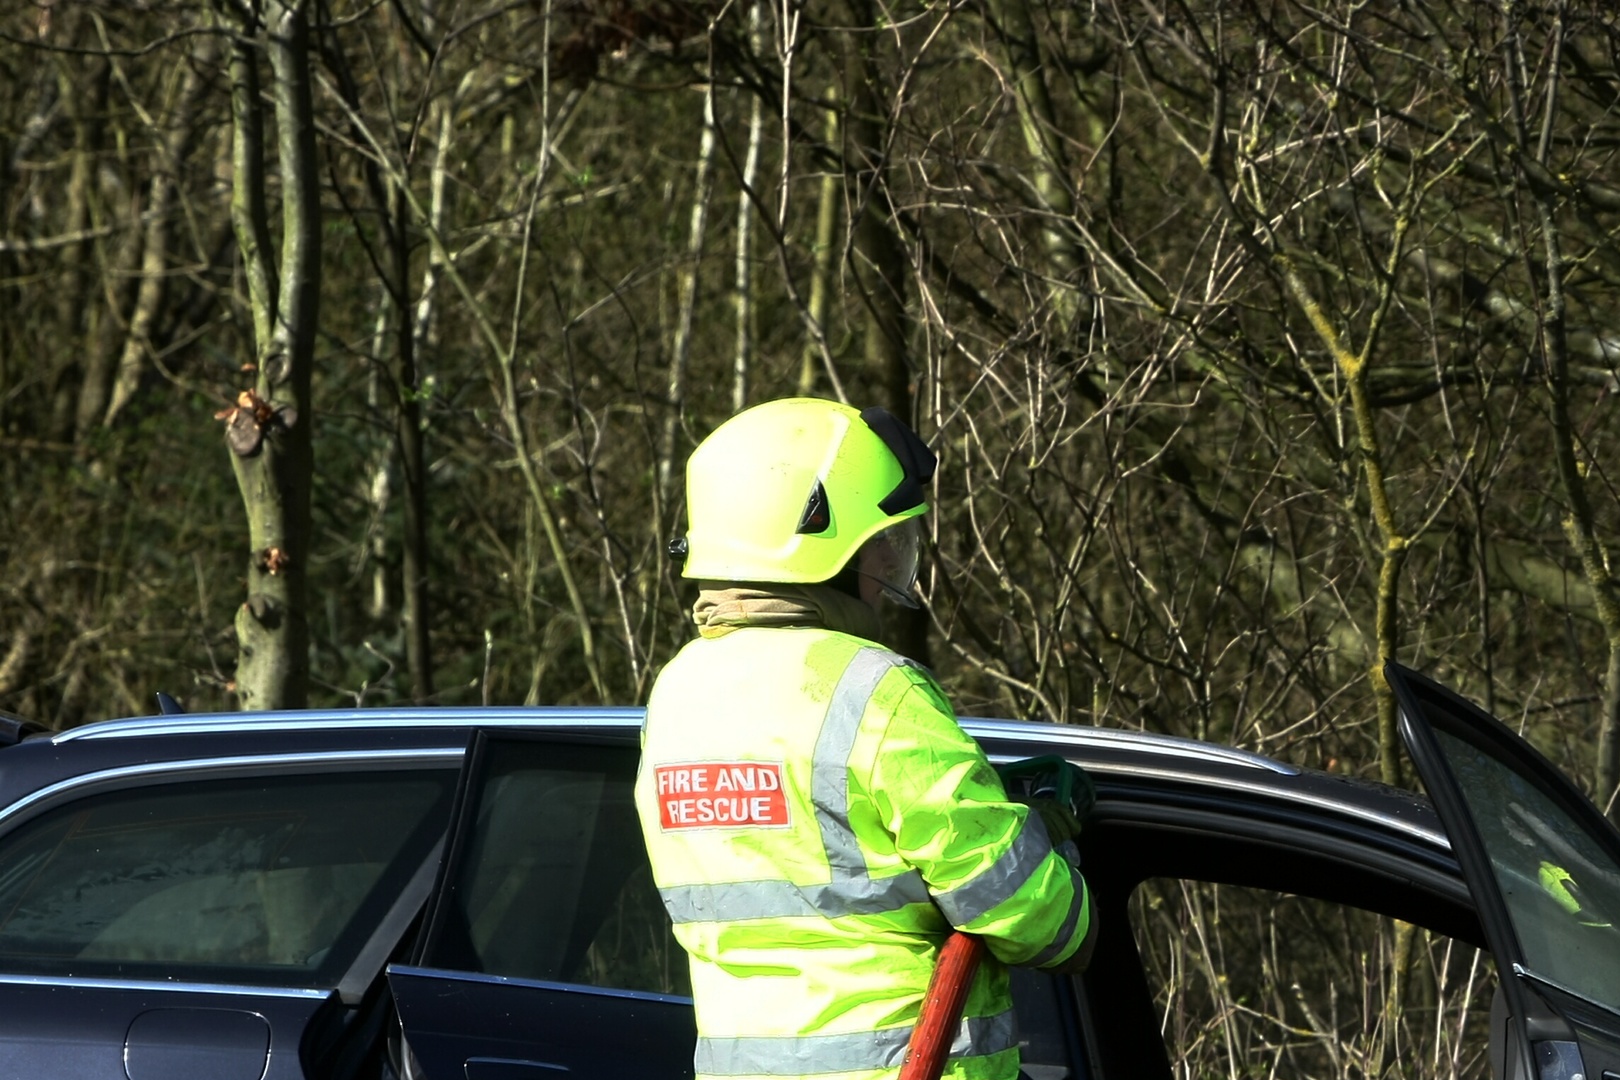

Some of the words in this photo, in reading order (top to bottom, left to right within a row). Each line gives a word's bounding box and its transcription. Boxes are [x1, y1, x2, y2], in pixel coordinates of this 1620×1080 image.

[657, 768, 708, 795] FIRE
[714, 767, 779, 792] AND
[667, 797, 772, 824] RESCUE
